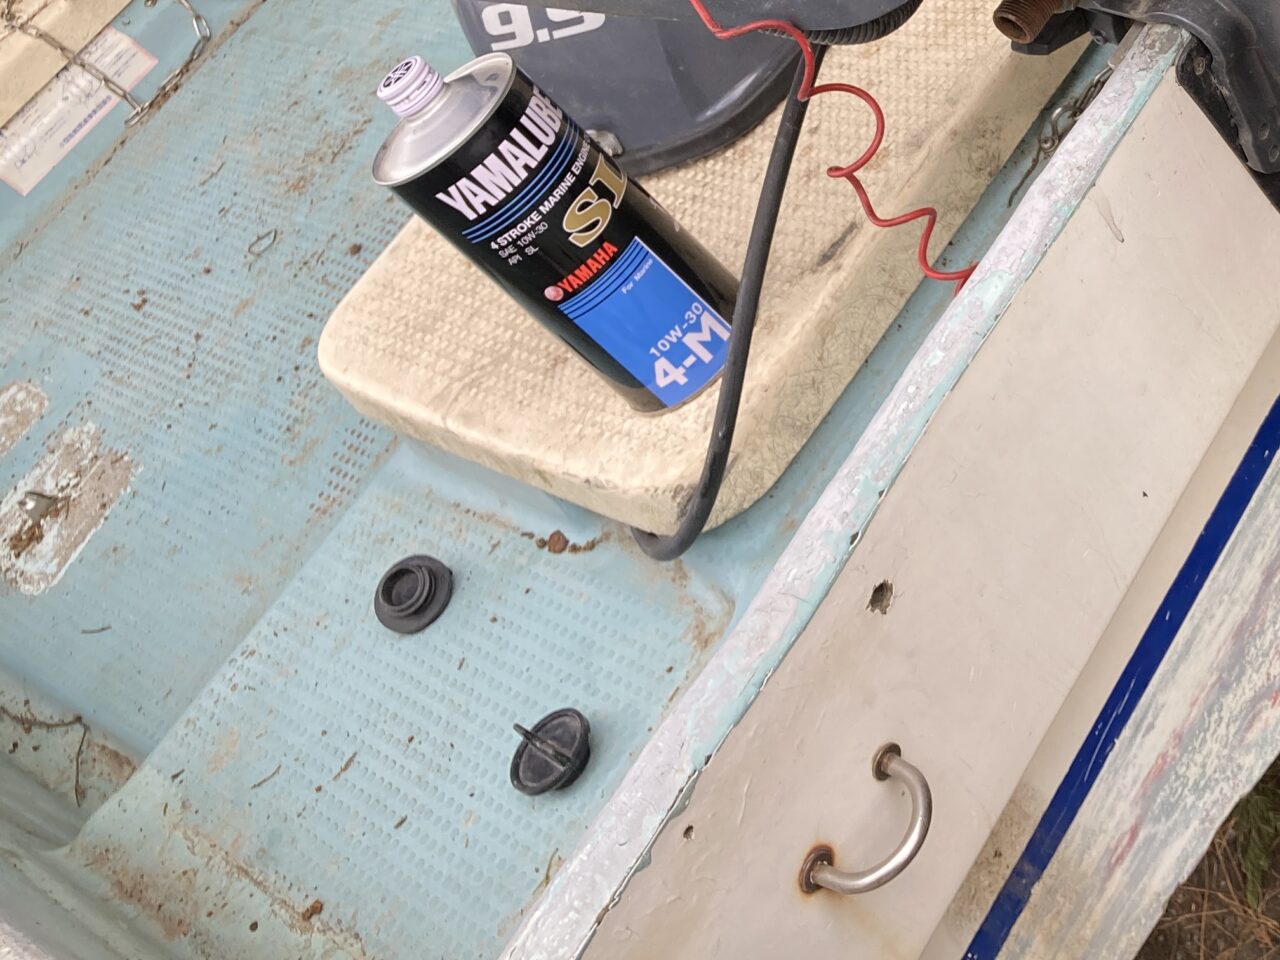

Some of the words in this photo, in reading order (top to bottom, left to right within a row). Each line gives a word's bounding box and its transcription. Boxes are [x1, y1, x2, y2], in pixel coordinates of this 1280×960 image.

[435, 84, 563, 221] YAMALUBE
[490, 240, 500, 250] 4
[497, 210, 542, 247] STROKE
[540, 171, 576, 214] MARINE
[571, 139, 591, 176] ENGINE
[498, 244, 518, 258] SAE
[517, 221, 549, 247] 10W-30
[507, 253, 523, 266] API
[525, 245, 540, 257] SL
[557, 241, 618, 293] YAMAHA
[621, 281, 635, 294] For
[633, 258, 654, 283] Marine
[649, 302, 703, 357] 10W-30
[654, 310, 731, 388] 4-M
